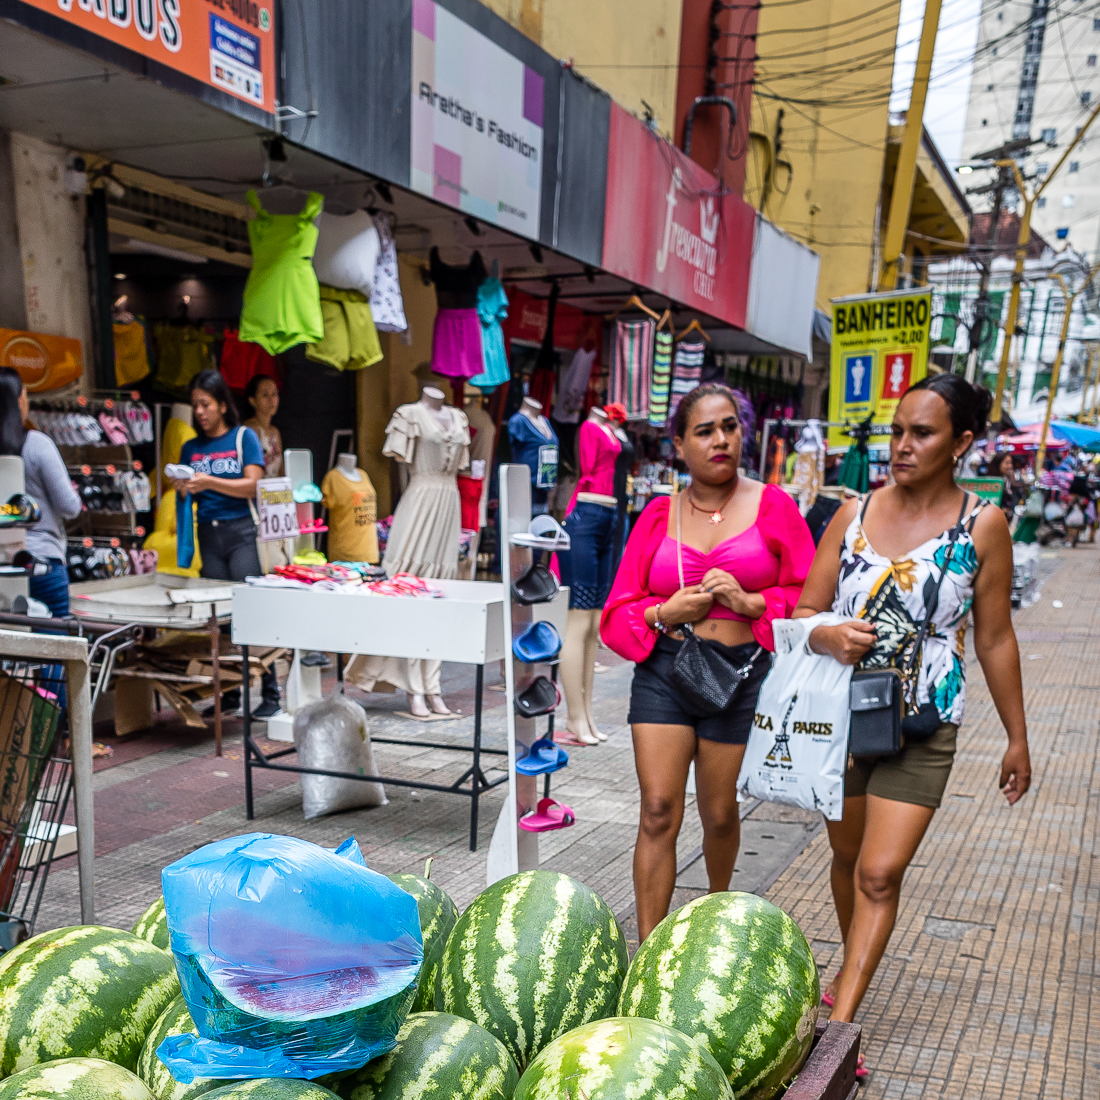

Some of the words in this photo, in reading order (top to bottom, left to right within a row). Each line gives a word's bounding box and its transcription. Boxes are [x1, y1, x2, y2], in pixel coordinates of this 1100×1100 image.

[419, 81, 485, 134] Aretha's
[488, 118, 538, 161] Fashion
[835, 298, 928, 334] BANHEIRO
[792, 721, 833, 735] PARIS
